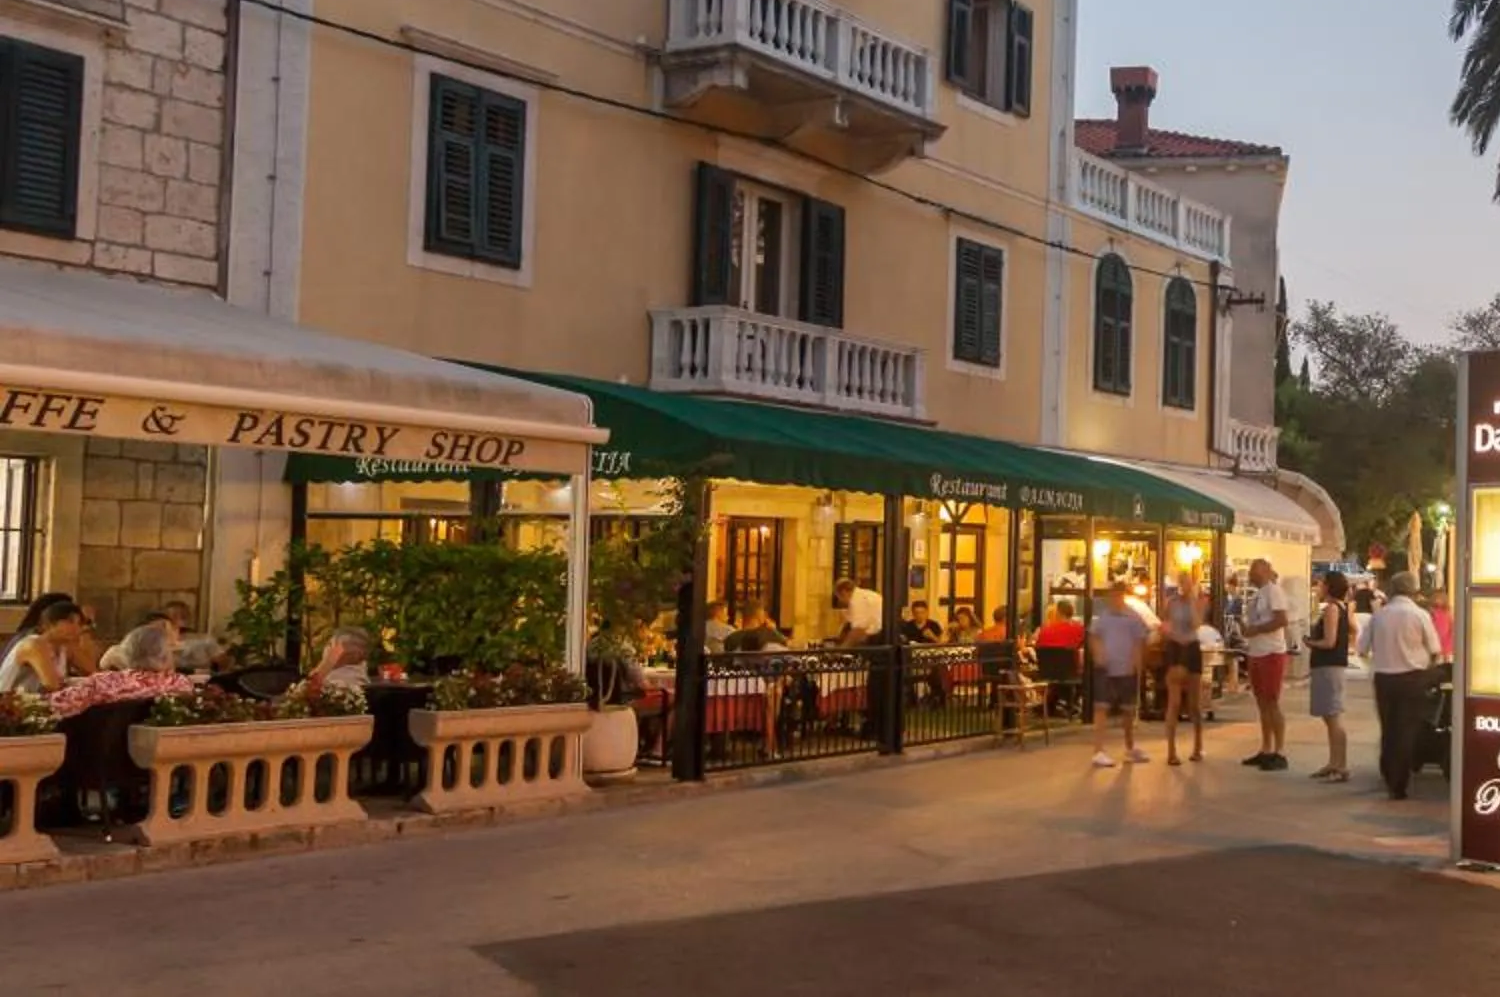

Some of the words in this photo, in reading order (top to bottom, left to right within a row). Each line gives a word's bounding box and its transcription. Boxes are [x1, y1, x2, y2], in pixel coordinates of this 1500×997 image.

[142, 406, 186, 435] &
[227, 411, 400, 455] PASTRY
[425, 430, 525, 466] SHOP
[929, 471, 1007, 501] Restaurant
